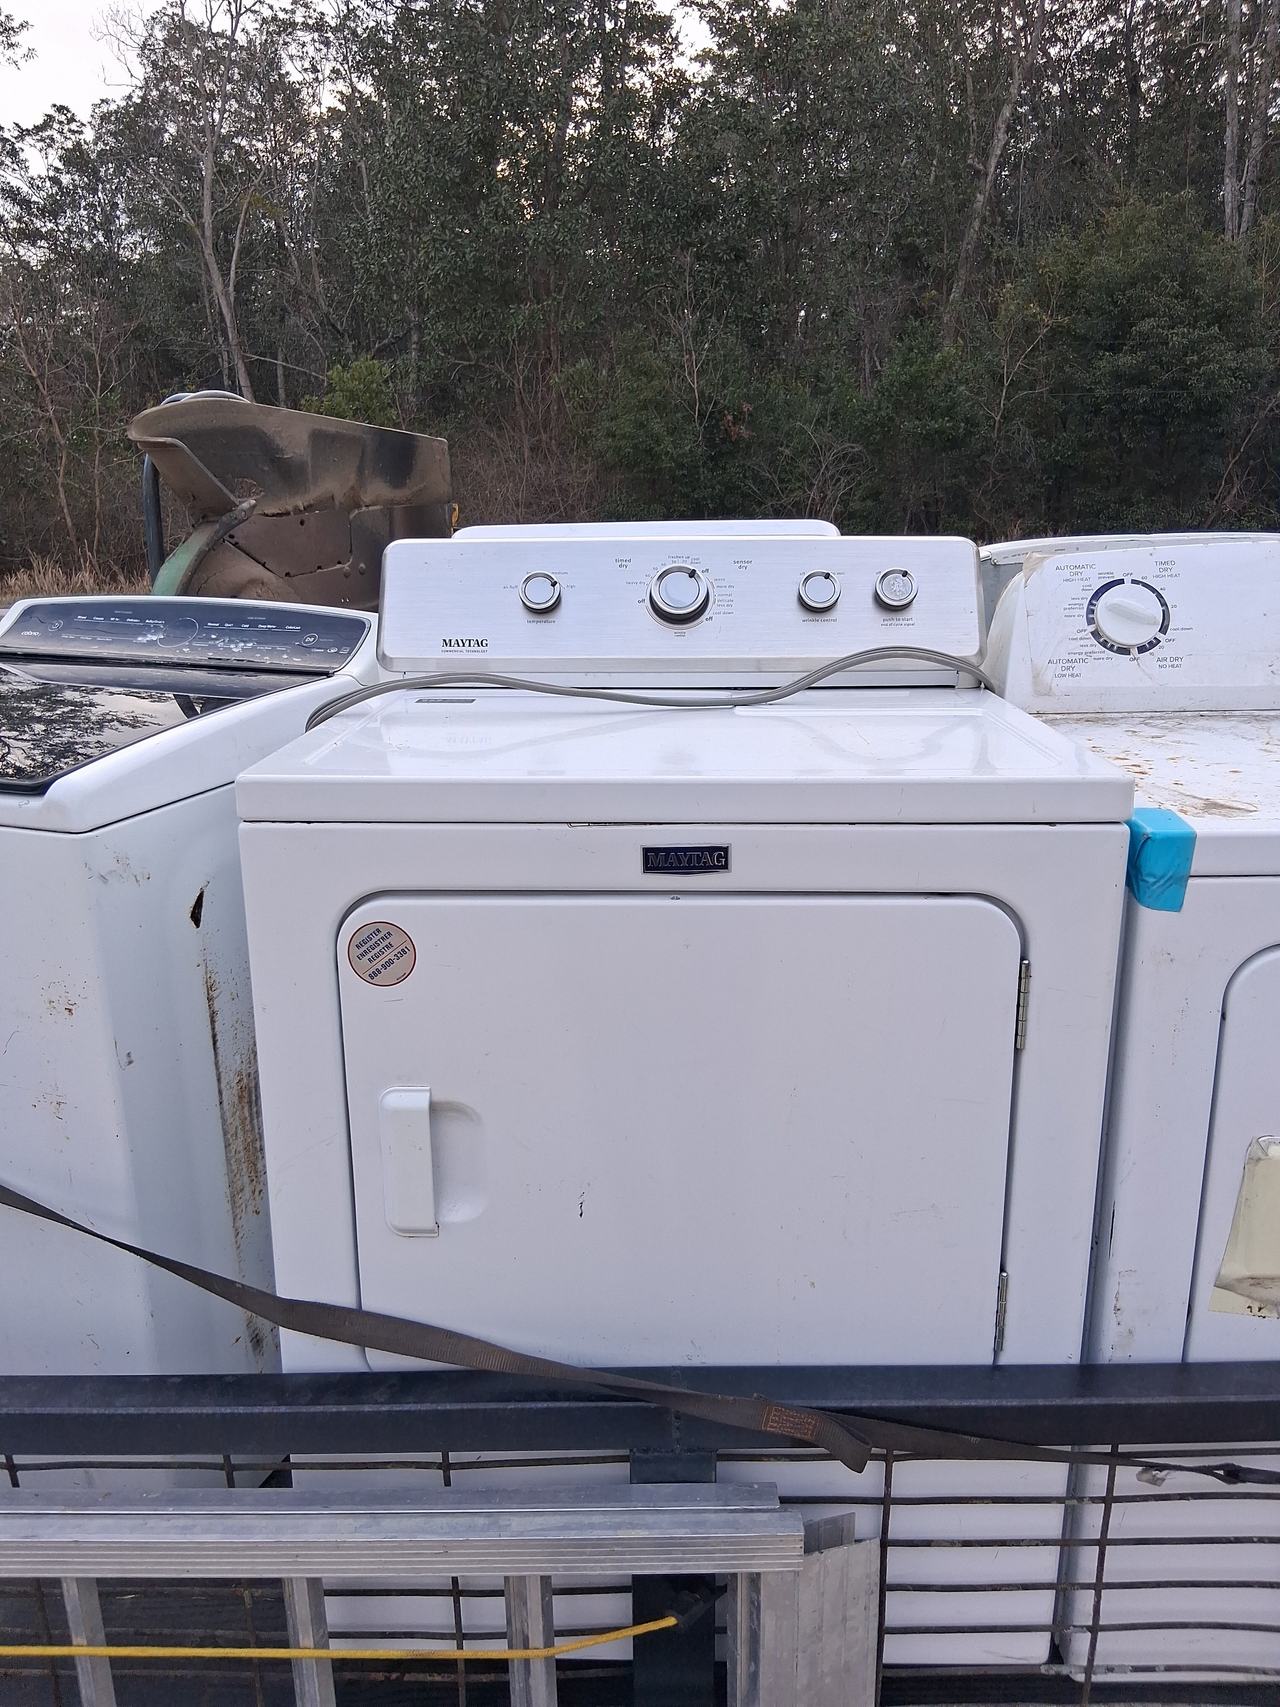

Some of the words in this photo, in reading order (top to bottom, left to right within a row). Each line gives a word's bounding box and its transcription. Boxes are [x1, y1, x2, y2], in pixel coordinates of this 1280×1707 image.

[1055, 563, 1096, 571] AUTOMATIC
[441, 638, 488, 648] MAYTAG
[1047, 657, 1089, 665] AUTOMATIC
[647, 851, 726, 867] MAYTAG
[355, 927, 382, 951] REGISTER
[356, 930, 393, 961] ENREGISTRER
[367, 941, 394, 964] REGISTRE
[368, 945, 411, 981] 888-900-3381
